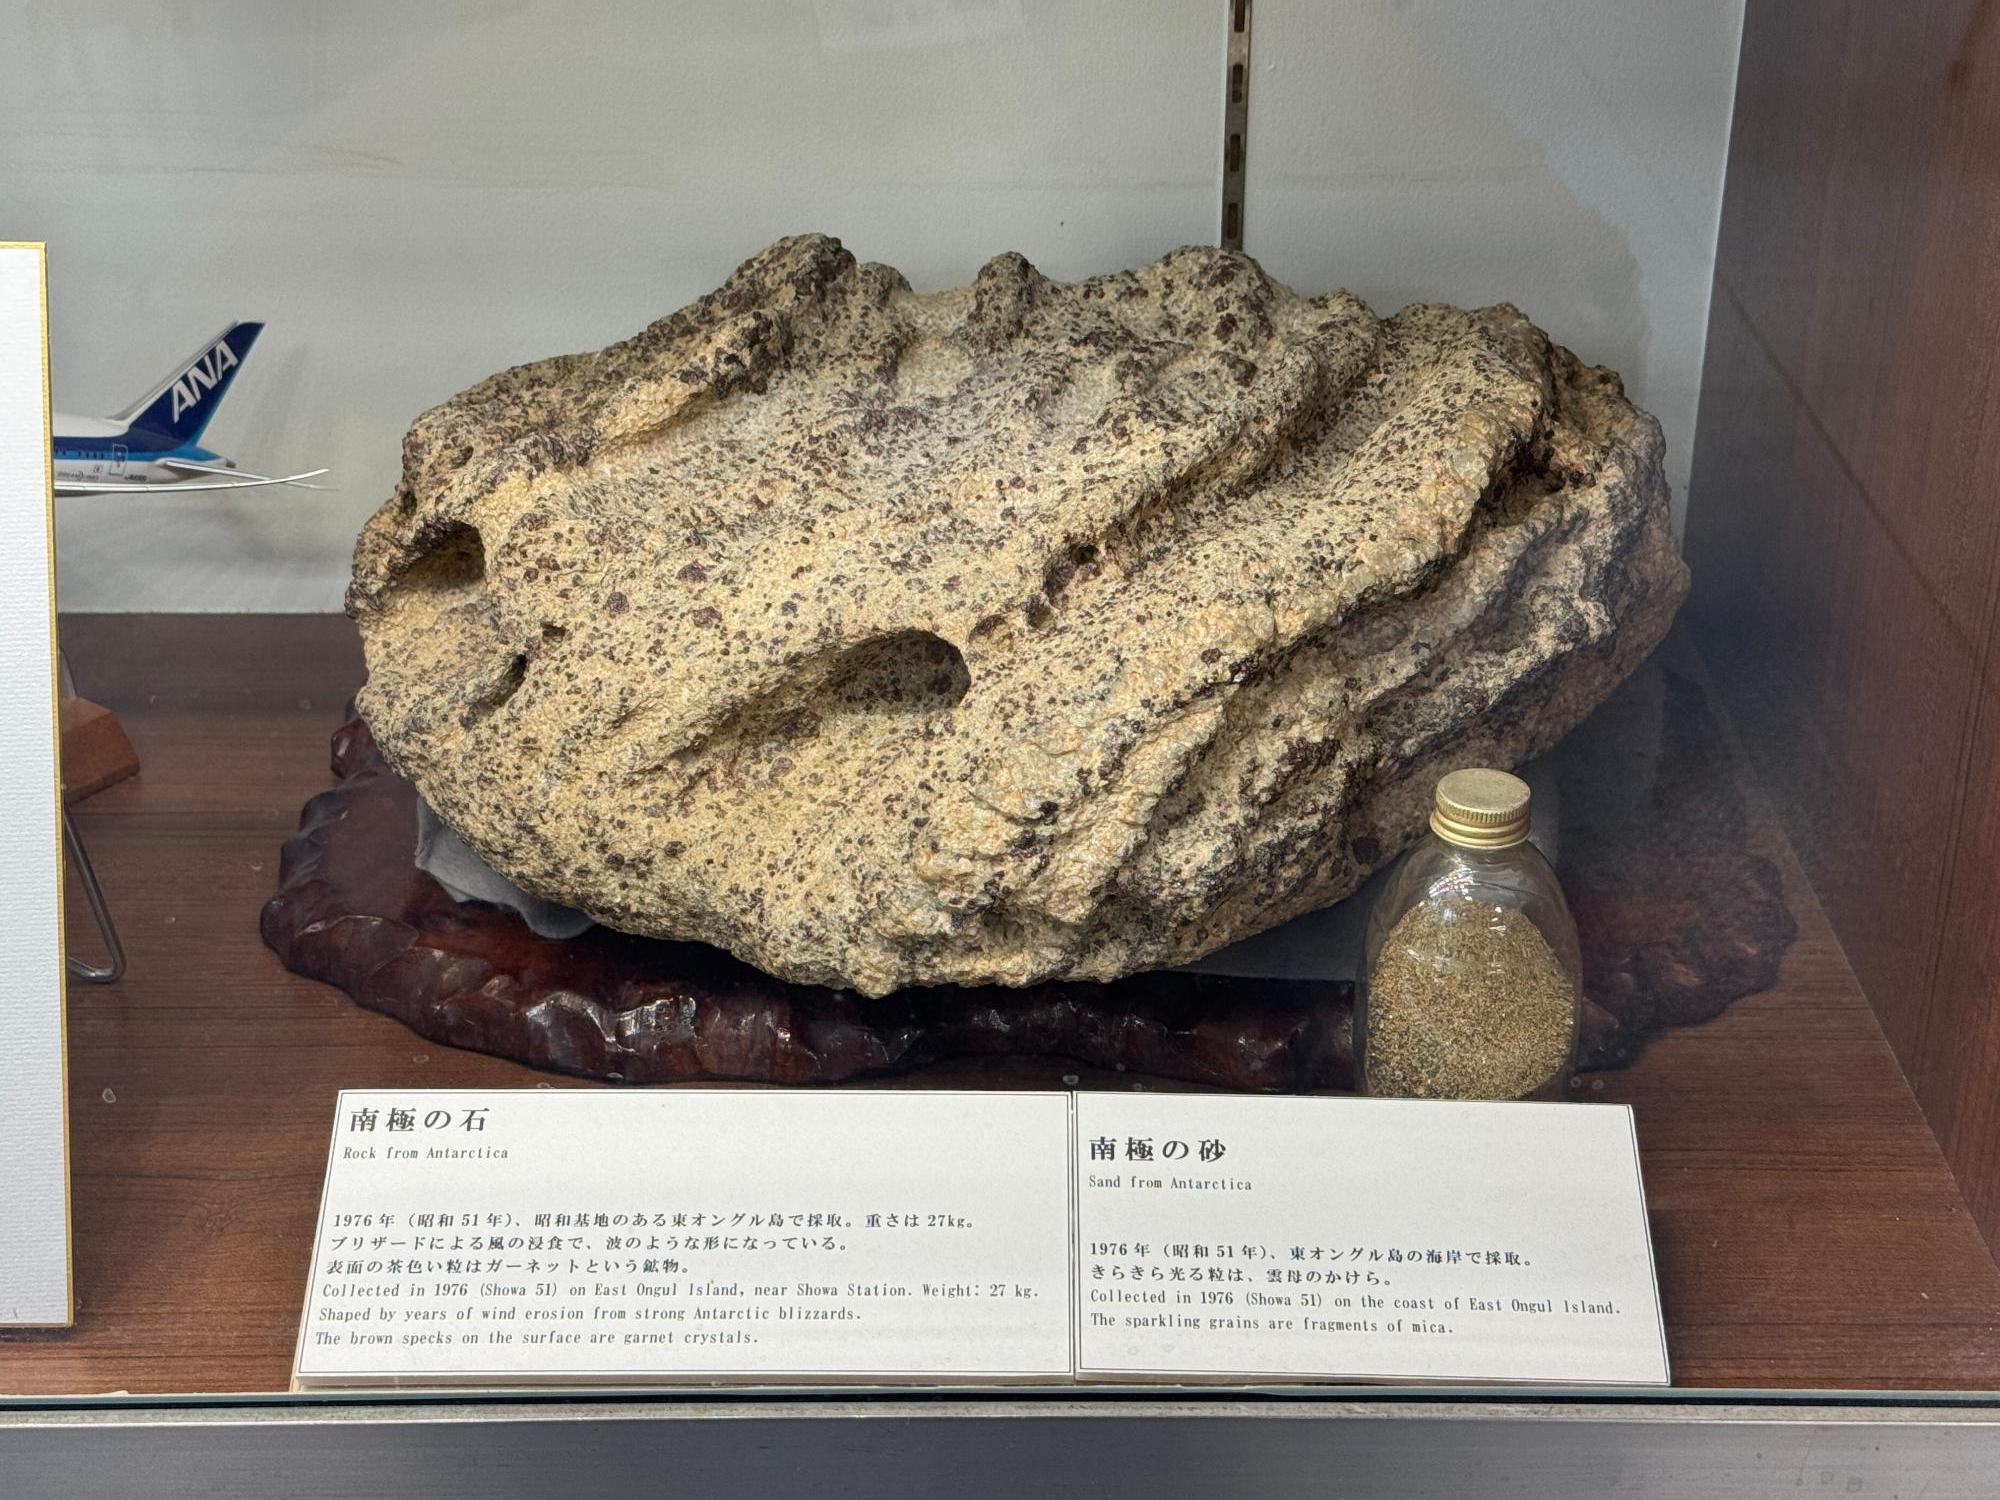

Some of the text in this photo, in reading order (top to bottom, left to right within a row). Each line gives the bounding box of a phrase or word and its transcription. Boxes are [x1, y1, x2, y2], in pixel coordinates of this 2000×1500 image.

[171, 339, 239, 424] ANA
[349, 1107, 491, 1133] 南極の石
[343, 1145, 508, 1160] Rock from Antarctica
[1088, 1135, 1227, 1164] 南極の砂
[1088, 1174, 1252, 1191] Sand from Antarctica
[331, 1235, 847, 1252] ブリザードによる風の浸食で、波のような形になっている。
[325, 1258, 689, 1275] 表面の茶色い粒はガーネットという鉱物。
[1090, 1264, 1391, 1286] きらきら光る粒は、雲母のかけら。
[322, 1281, 1039, 1300] Collected in 1976 (Showa 51) on East Ongul Island, near Showa Station. Weight: 27 kg.
[1090, 1288, 1621, 1315] Collected in 1976 (Showa 51) on the coast of East Ongul Island.
[319, 1306, 861, 1324] Shaped by years of wind erosion from strong Antarctic blizzards.
[1090, 1312, 1454, 1335] The sparkling grains are fragments of mica.
[315, 1330, 758, 1347] The brown specks on the surface are garnet crystals.
